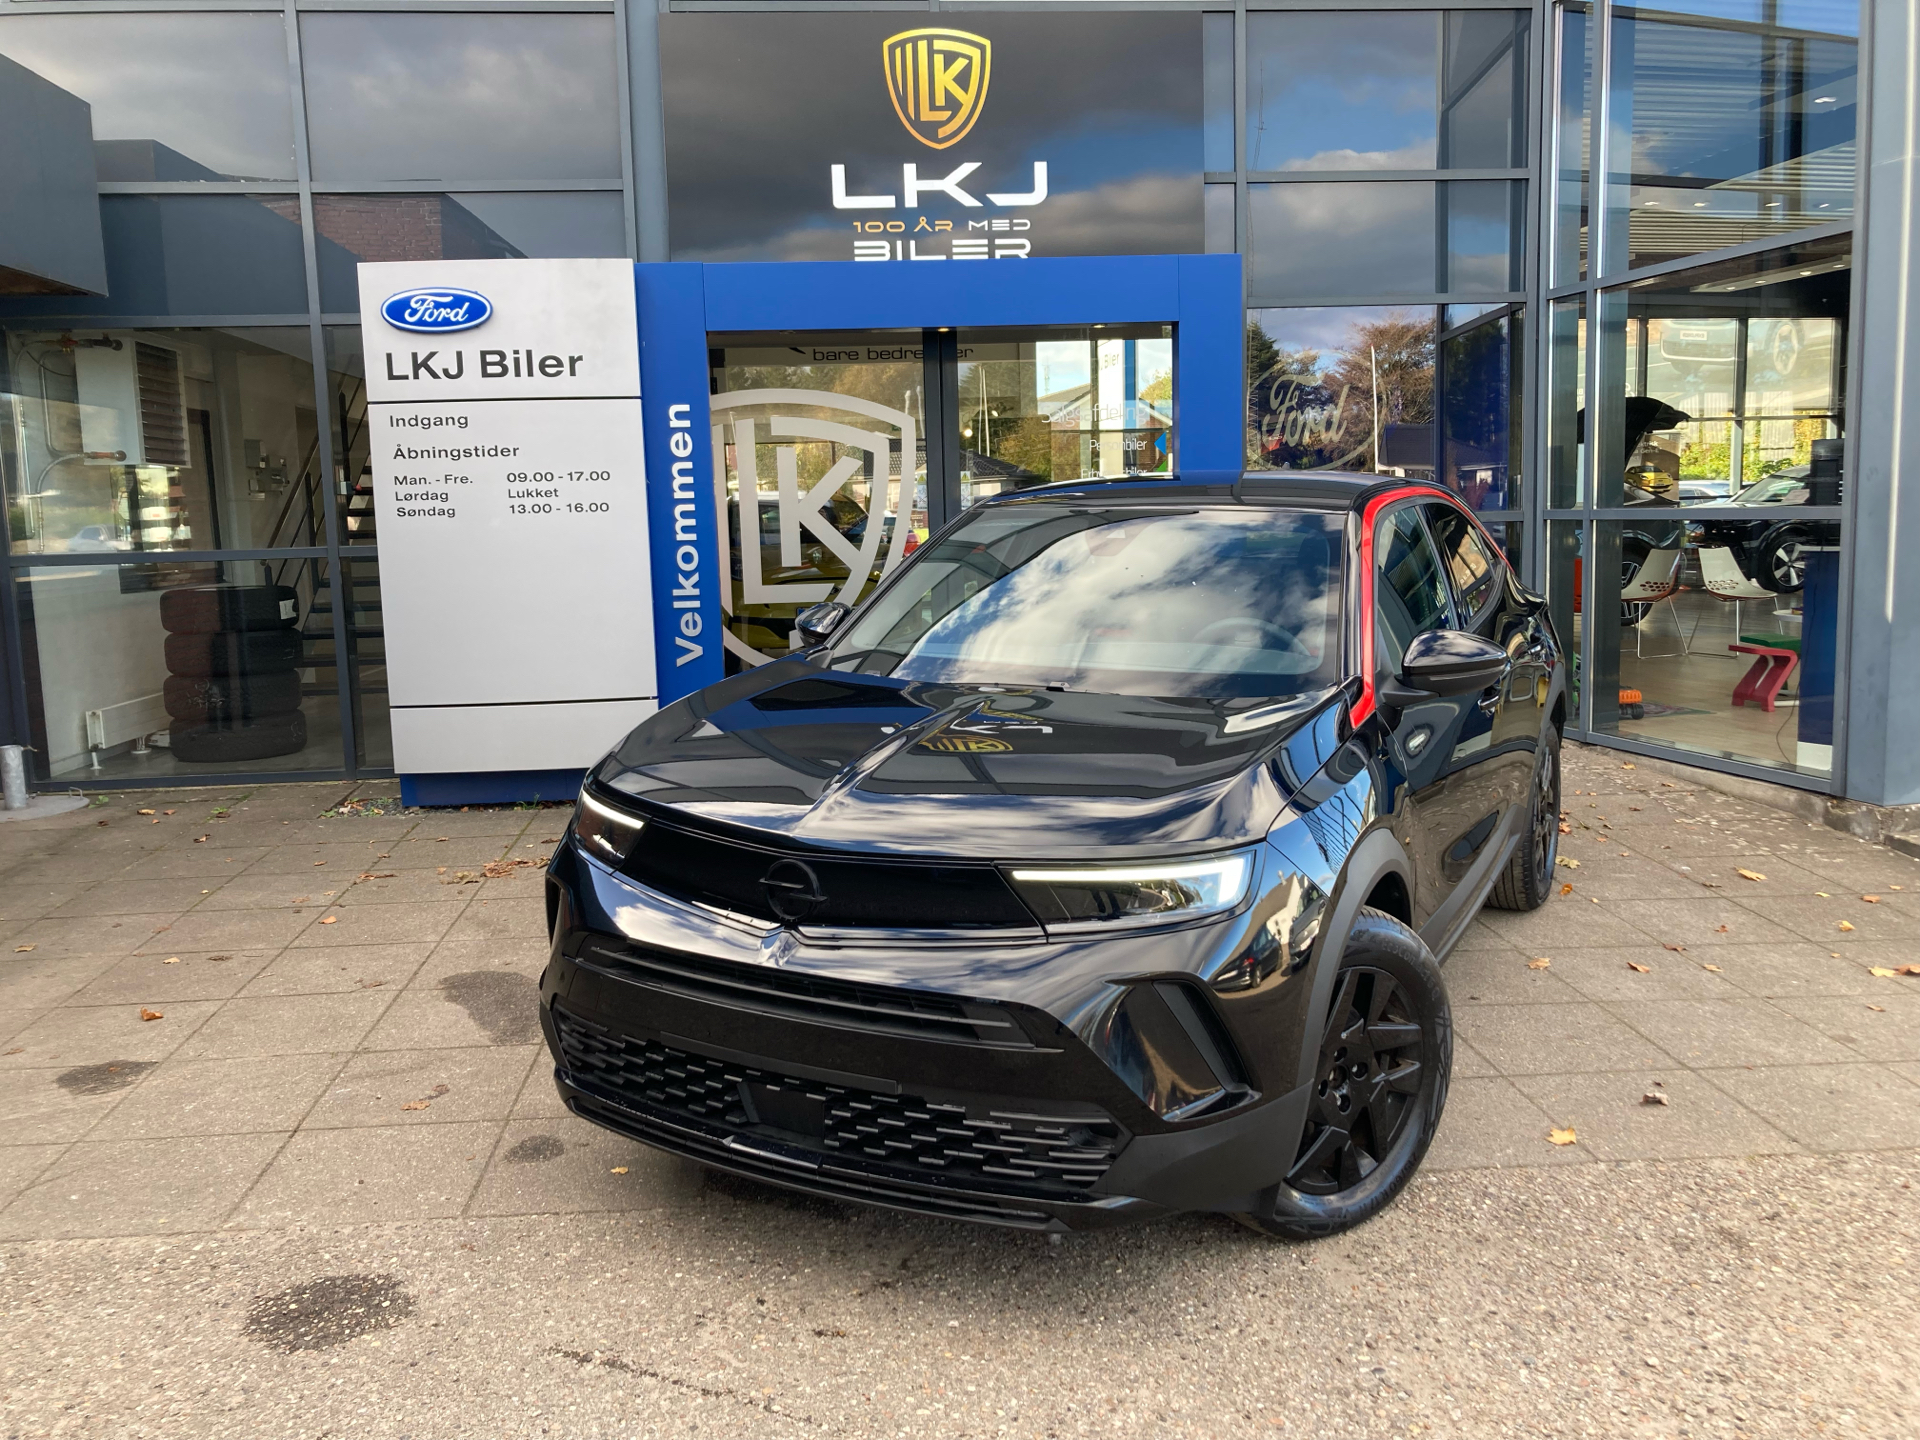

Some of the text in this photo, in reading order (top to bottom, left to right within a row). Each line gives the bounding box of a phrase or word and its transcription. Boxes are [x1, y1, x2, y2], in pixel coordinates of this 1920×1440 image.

[831, 161, 1048, 209] LKJ
[853, 216, 1031, 232] 100 ÅR MED
[853, 238, 1031, 262] BILER
[404, 294, 470, 323] Ford
[813, 348, 859, 361] bare
[385, 349, 584, 380] LKJ Biler
[1261, 374, 1350, 447] Ford
[389, 415, 469, 430] Indgang
[393, 444, 519, 461] Åbningstider
[394, 475, 432, 486] Man.
[444, 474, 473, 485] Fre.
[395, 488, 559, 503] Lørdag Lukket
[396, 506, 456, 518] Søndag
[668, 403, 704, 667] Velkommen
